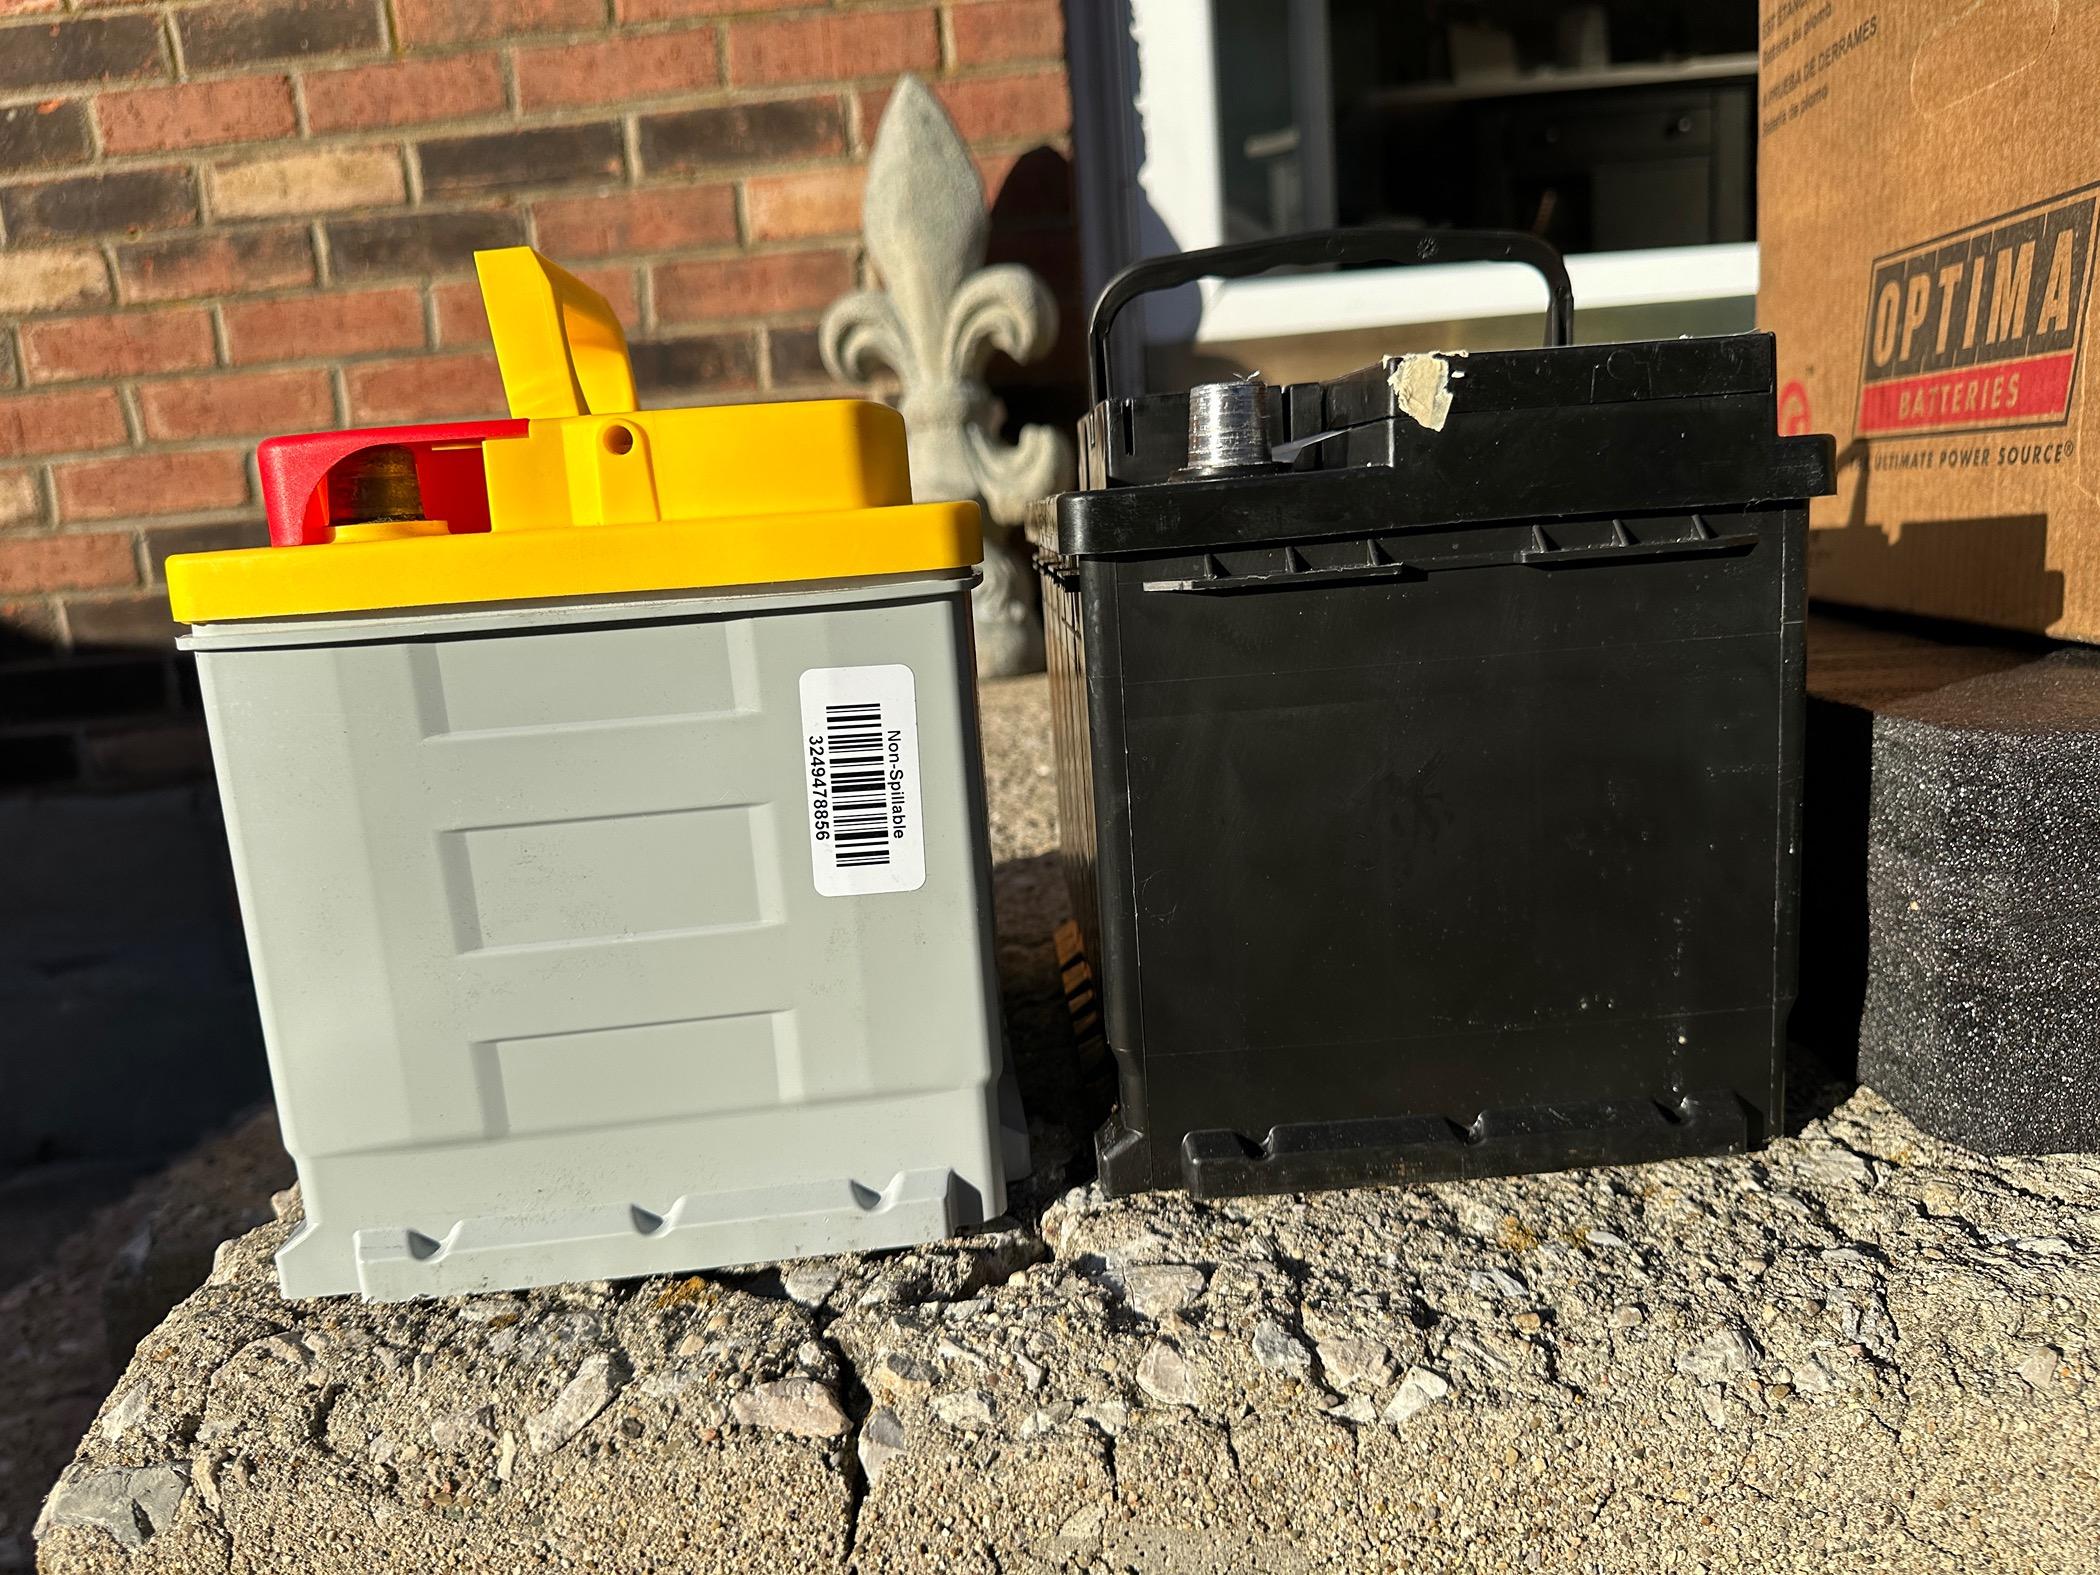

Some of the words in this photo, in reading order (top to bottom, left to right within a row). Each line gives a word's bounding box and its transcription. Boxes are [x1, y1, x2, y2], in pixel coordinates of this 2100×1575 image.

[1803, 55, 1817, 82] DE
[1818, 14, 1878, 72] DERRAMES
[1872, 228, 2074, 368] OPTIMA
[1898, 372, 2021, 420] BATTERIES
[1874, 451, 1934, 471] ULTIMATE
[1940, 447, 1989, 468] POWER
[809, 735, 830, 841] 3249478856
[887, 730, 906, 839] Non-Spillable
